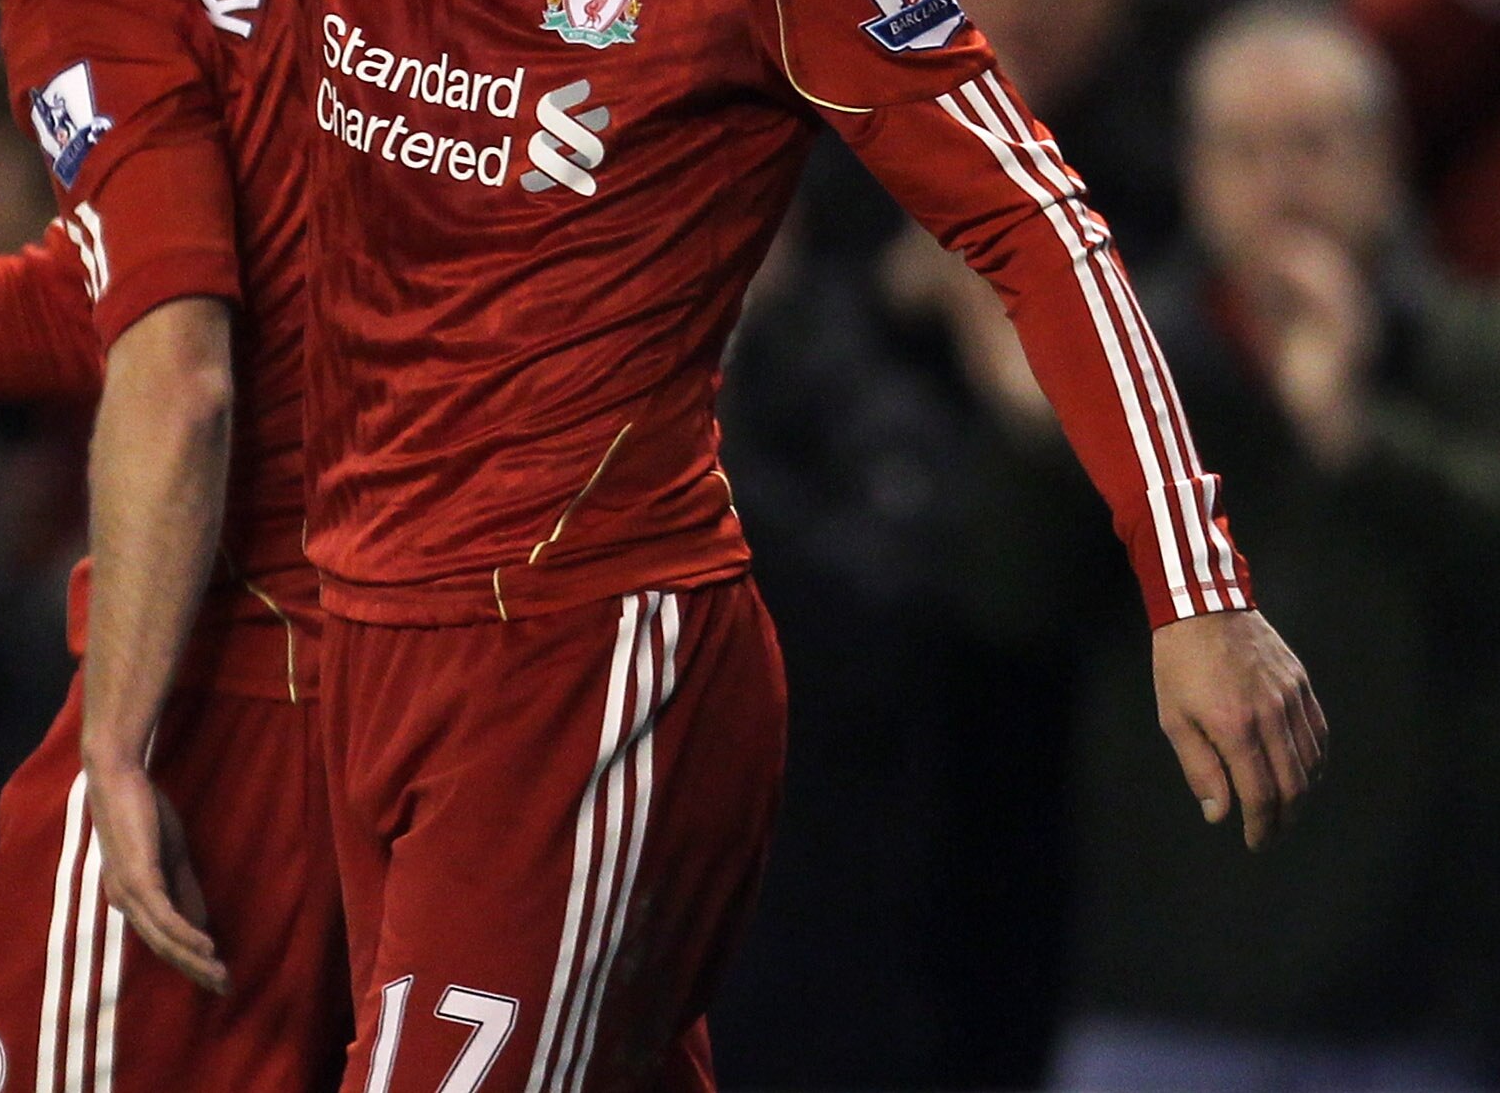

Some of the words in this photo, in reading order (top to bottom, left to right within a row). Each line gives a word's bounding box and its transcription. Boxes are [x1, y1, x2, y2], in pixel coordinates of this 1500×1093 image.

[321, 14, 525, 119] Standard
[316, 77, 512, 187] Chartered
[364, 974, 520, 1093] 17
